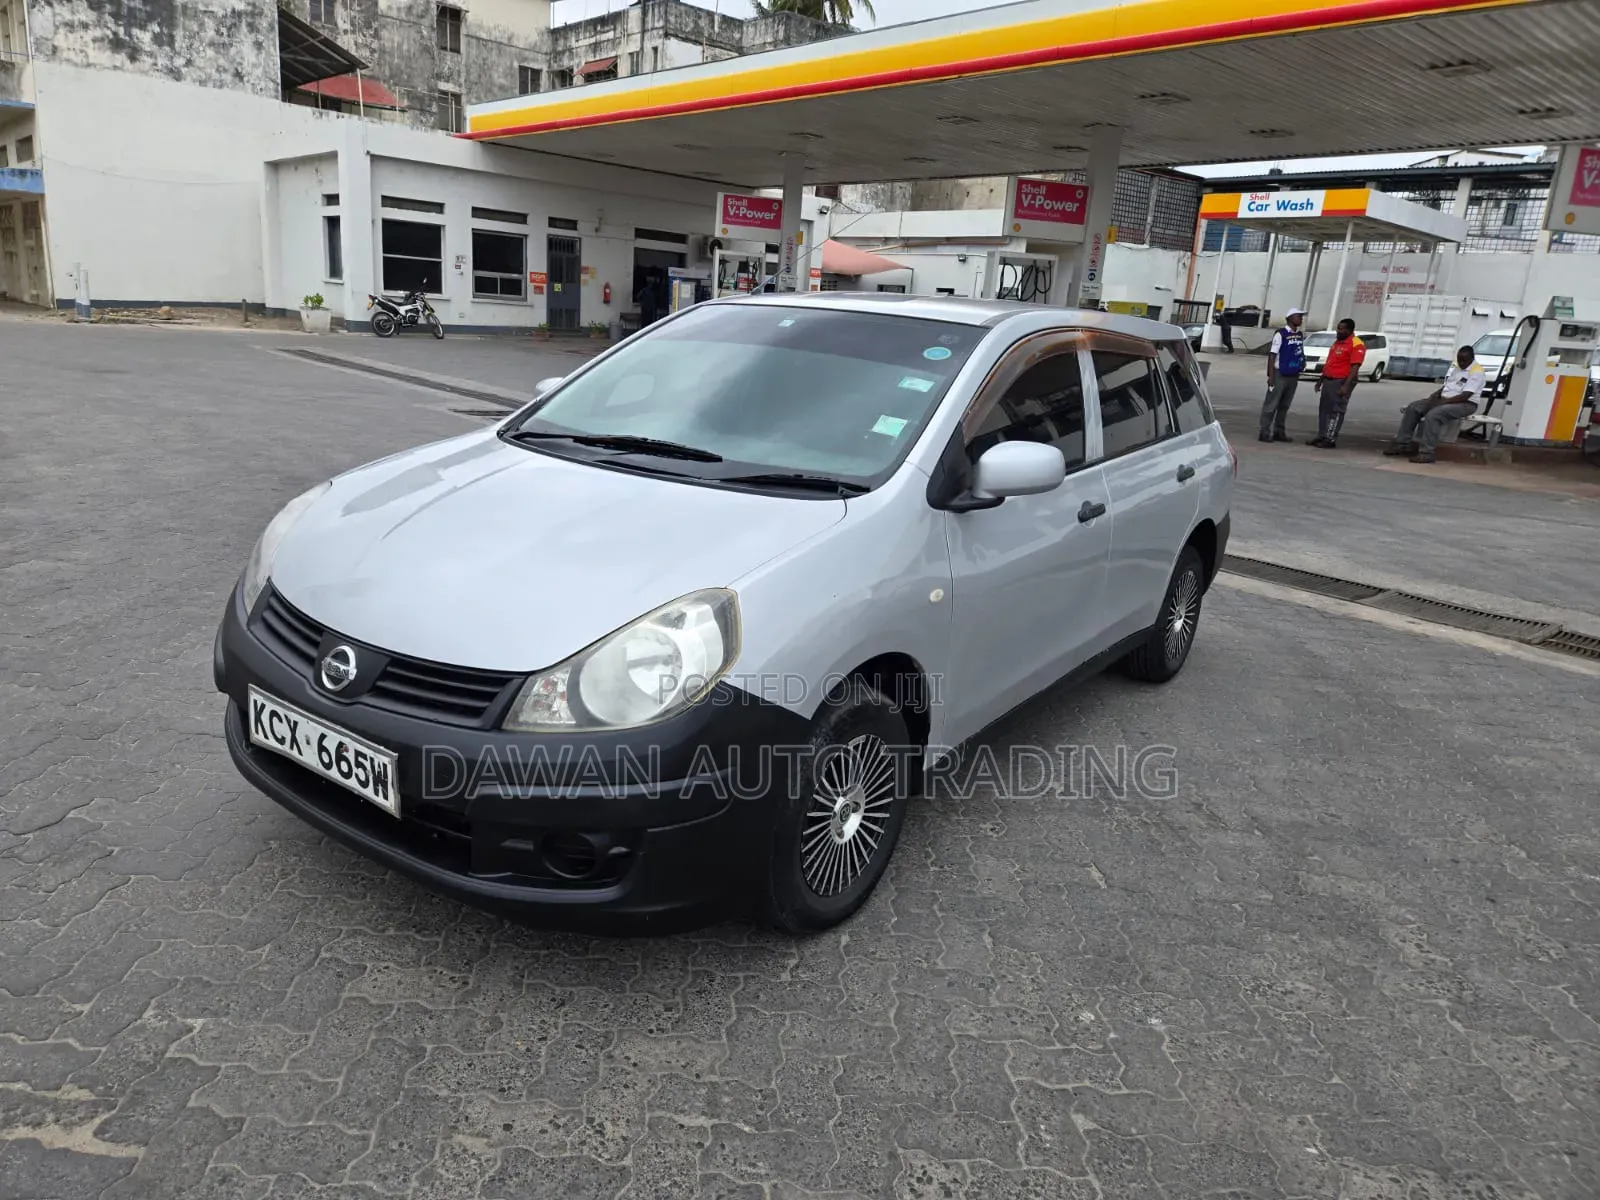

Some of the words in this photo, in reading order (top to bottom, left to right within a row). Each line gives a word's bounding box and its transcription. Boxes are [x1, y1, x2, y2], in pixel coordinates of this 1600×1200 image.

[1021, 184, 1046, 195] Shell
[728, 198, 748, 207] Shell
[1249, 192, 1270, 201] Shell
[1022, 194, 1079, 212] V-Power
[1247, 200, 1271, 212] Car
[1276, 198, 1314, 211] Wash
[728, 206, 776, 220] V-Power
